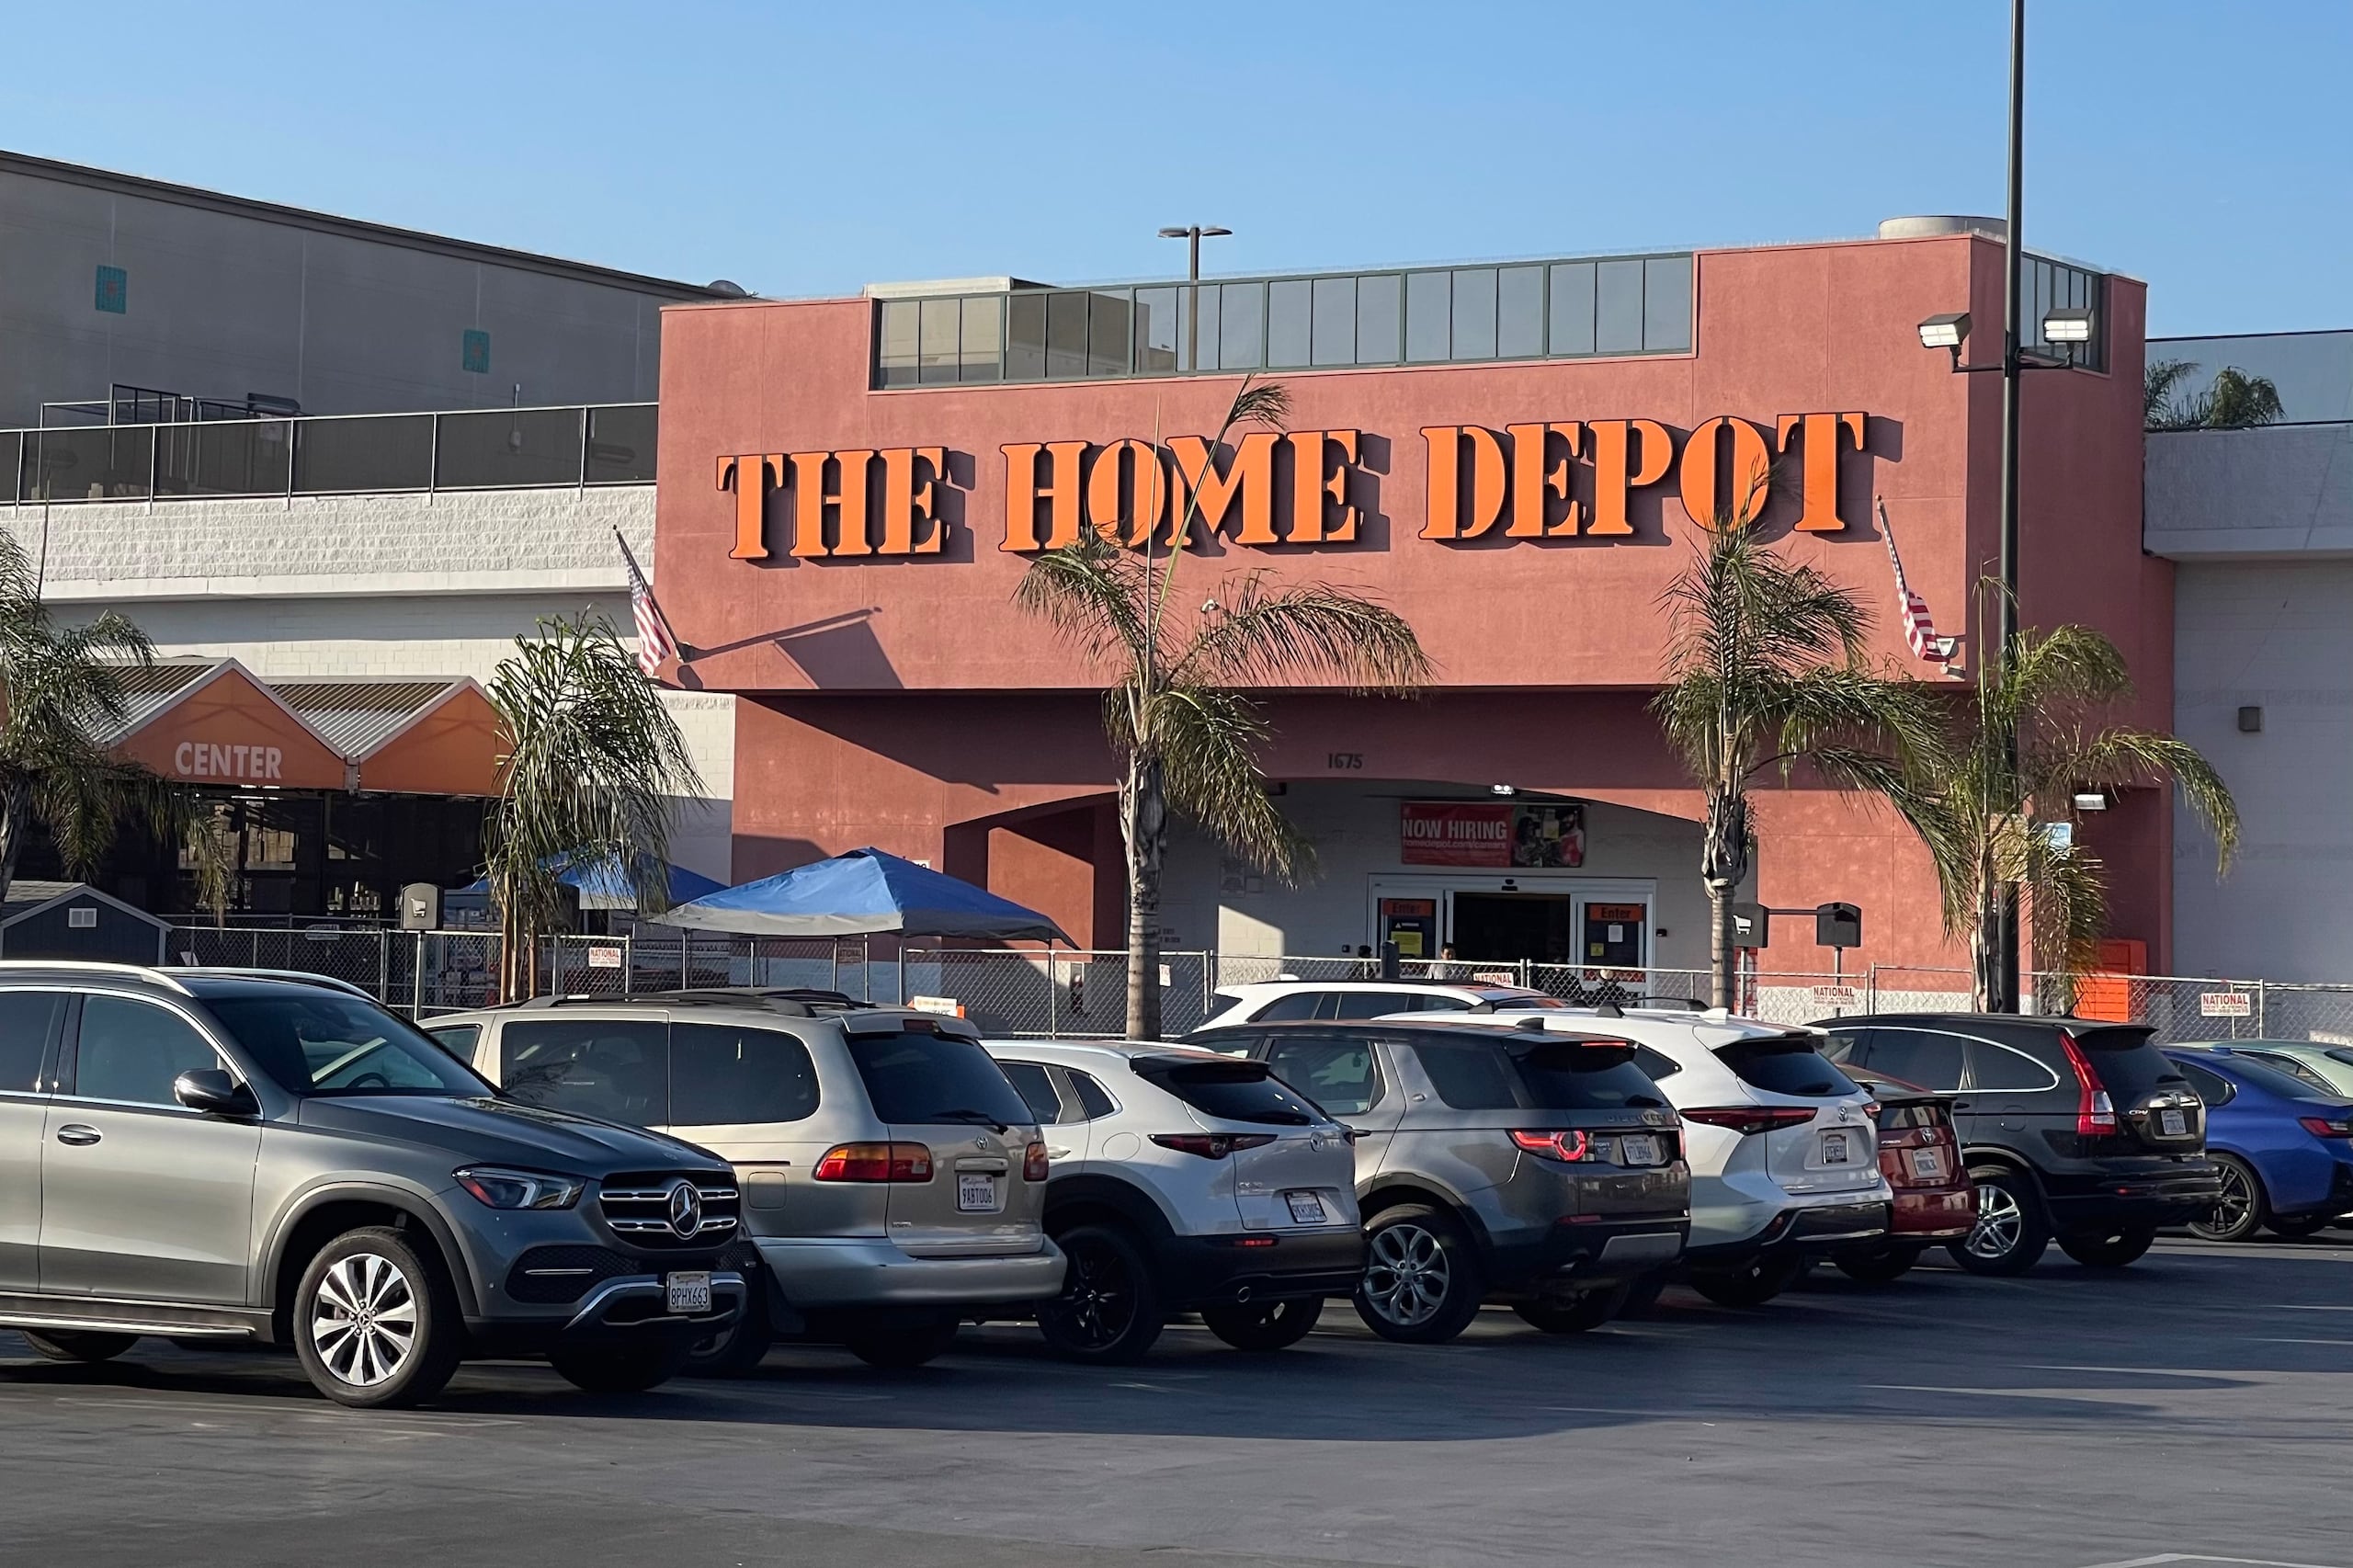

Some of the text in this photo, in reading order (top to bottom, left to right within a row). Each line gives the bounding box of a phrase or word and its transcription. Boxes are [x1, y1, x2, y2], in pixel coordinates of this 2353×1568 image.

[716, 412, 1868, 559] THE HOME DEPOT
[175, 742, 282, 778] CENTER
[1328, 753, 1363, 769] 1675
[1403, 819, 1507, 839] NOW HIRING
[1392, 903, 1420, 914] Enter
[1601, 907, 1631, 919] Enter
[590, 949, 620, 958] NATIONAL
[1474, 974, 1512, 983] NATIONAL
[1813, 987, 1855, 997] NATIONAL
[2202, 994, 2248, 1006] NATIONAL
[671, 1287, 708, 1305] 8PHX663
